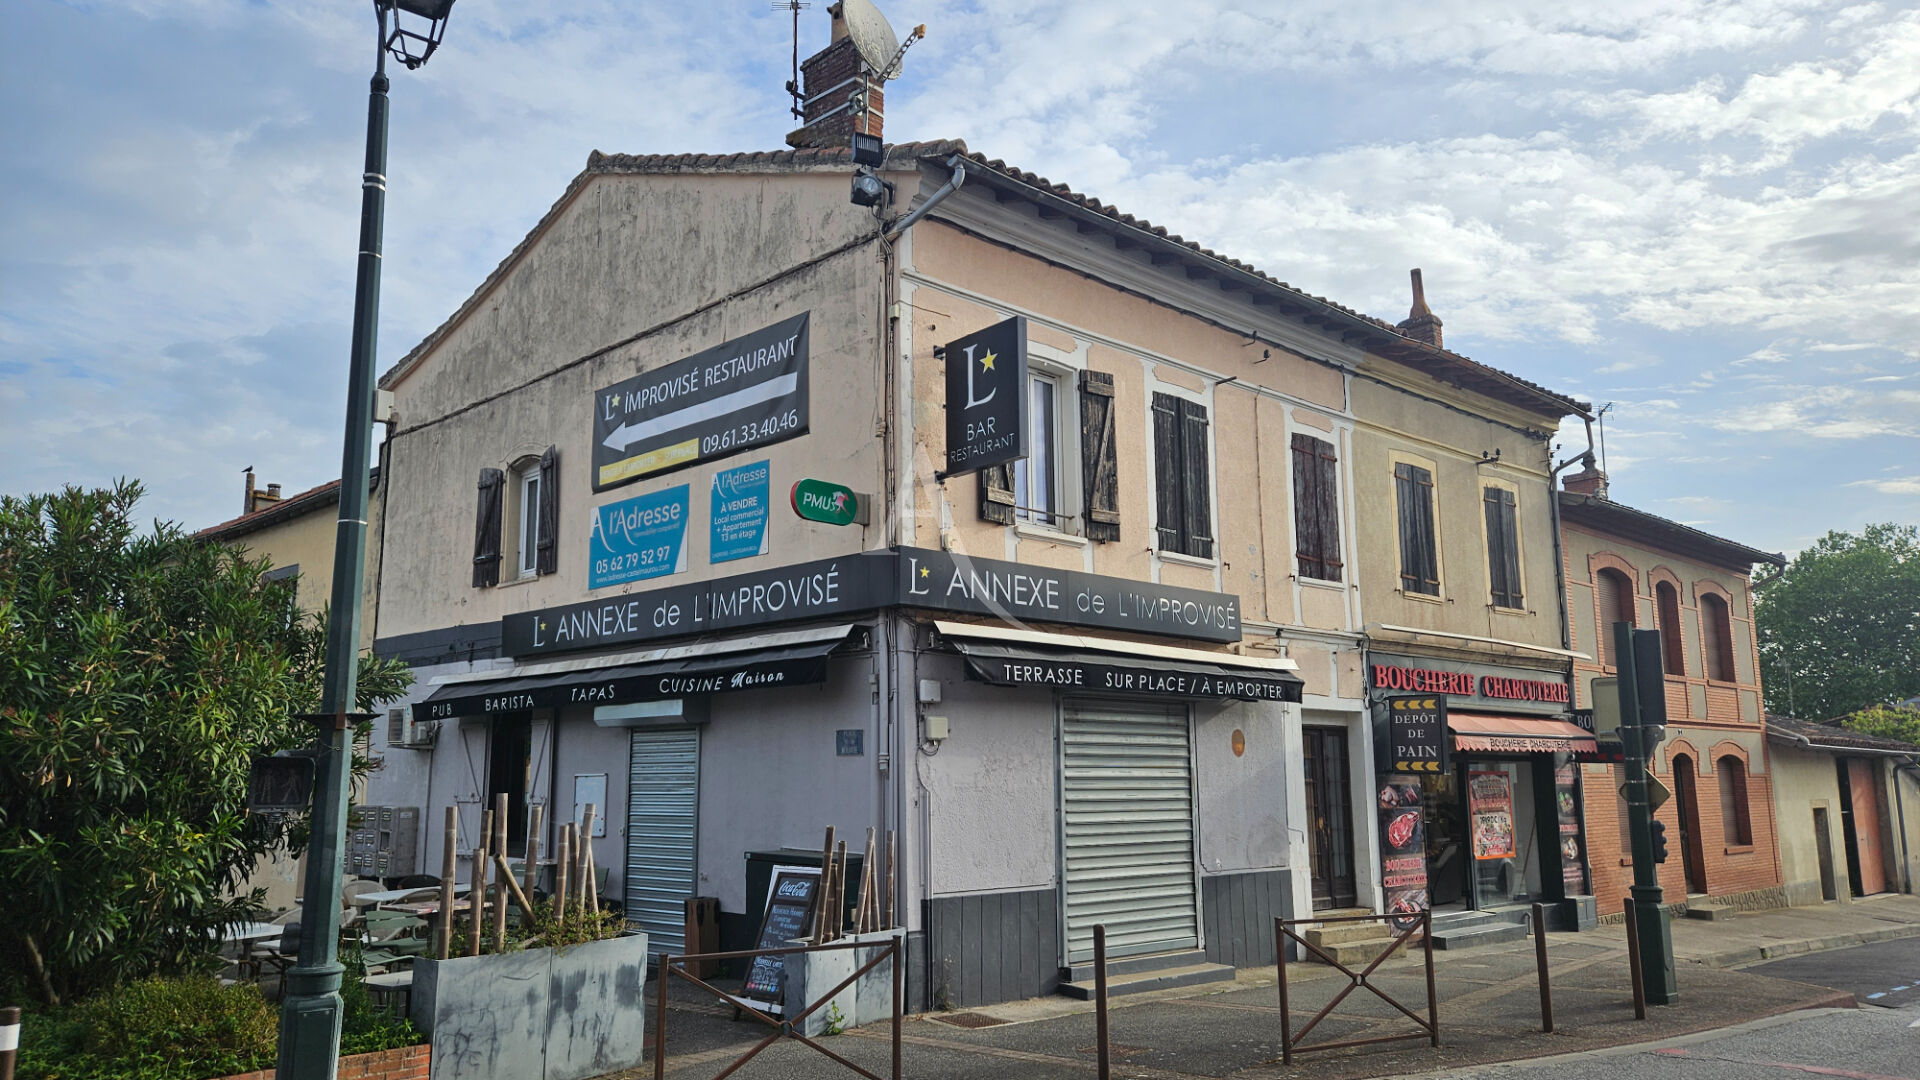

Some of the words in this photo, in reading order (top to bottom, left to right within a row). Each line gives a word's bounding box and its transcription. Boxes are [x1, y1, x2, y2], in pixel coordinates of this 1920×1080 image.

[705, 334, 798, 387] RESTAURANT
[962, 343, 997, 410] L
[703, 408, 798, 454] 09.61.33.40.46
[967, 416, 996, 441] BAR
[950, 432, 1015, 463] RESTAURANT
[714, 514, 730, 525] Local
[730, 506, 764, 521] commercial
[728, 496, 758, 511] VENDRE
[803, 491, 831, 510] PMU
[609, 503, 681, 546] l'Adresse
[722, 518, 762, 533] Appartement
[596, 559, 608, 574] 05
[610, 556, 623, 571] 62
[626, 553, 638, 568] 79
[641, 549, 654, 565] 52
[657, 546, 670, 562] 97
[908, 558, 929, 595] L
[946, 566, 1060, 609] ANNEXE
[1077, 587, 1105, 614] de
[1119, 592, 1236, 630] L'IMPROVISÉ
[555, 602, 638, 643] ANNEXE
[653, 600, 681, 628] de
[432, 704, 452, 716] PUB
[485, 694, 534, 712] BARISTA
[571, 683, 615, 701] TAPAS
[659, 676, 722, 693] CUISINE
[731, 671, 785, 688] Maison
[1003, 664, 1083, 685] TERRASSE
[1105, 672, 1133, 689] SUR
[1139, 675, 1185, 693] PLACE
[1201, 678, 1212, 693] À
[1217, 681, 1283, 699] EMPORTER
[1373, 664, 1476, 697] BOUCHERIE
[1482, 675, 1570, 703] CHARCUTERIE
[1395, 712, 1437, 724] DÉPÔT
[1408, 729, 1425, 738] DE
[1397, 746, 1437, 757] PAIN
